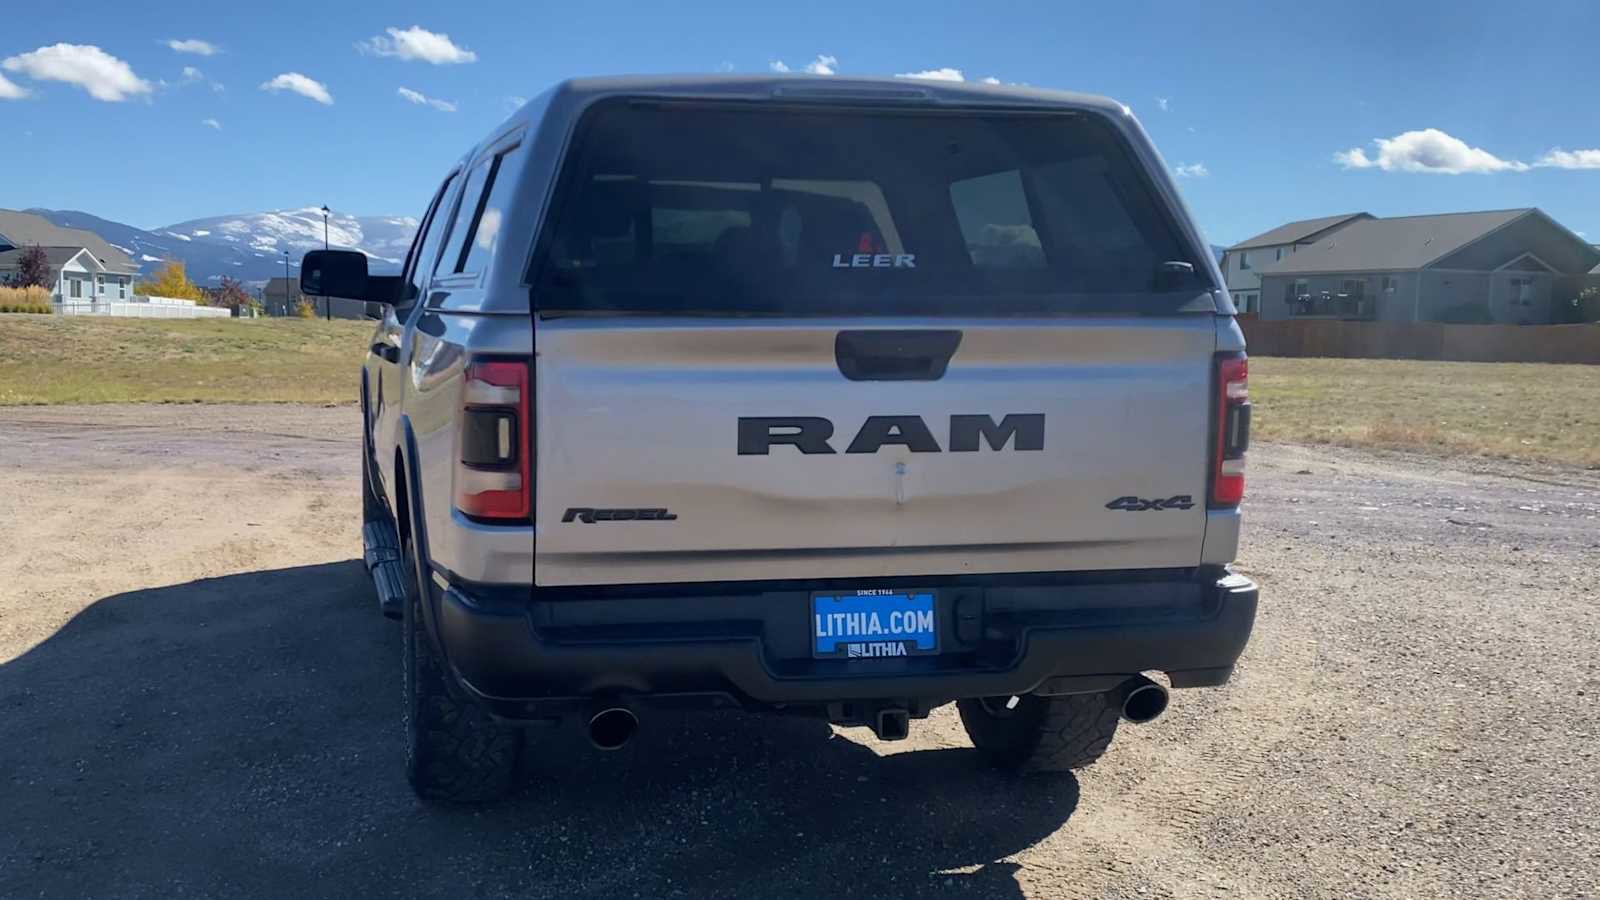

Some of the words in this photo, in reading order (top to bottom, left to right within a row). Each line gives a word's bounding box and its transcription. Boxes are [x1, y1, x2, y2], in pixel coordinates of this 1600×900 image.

[832, 254, 916, 267] LEER
[737, 414, 1045, 455] RAM
[815, 610, 933, 637] LITHIA.COM
[861, 642, 907, 657] LITHIA
